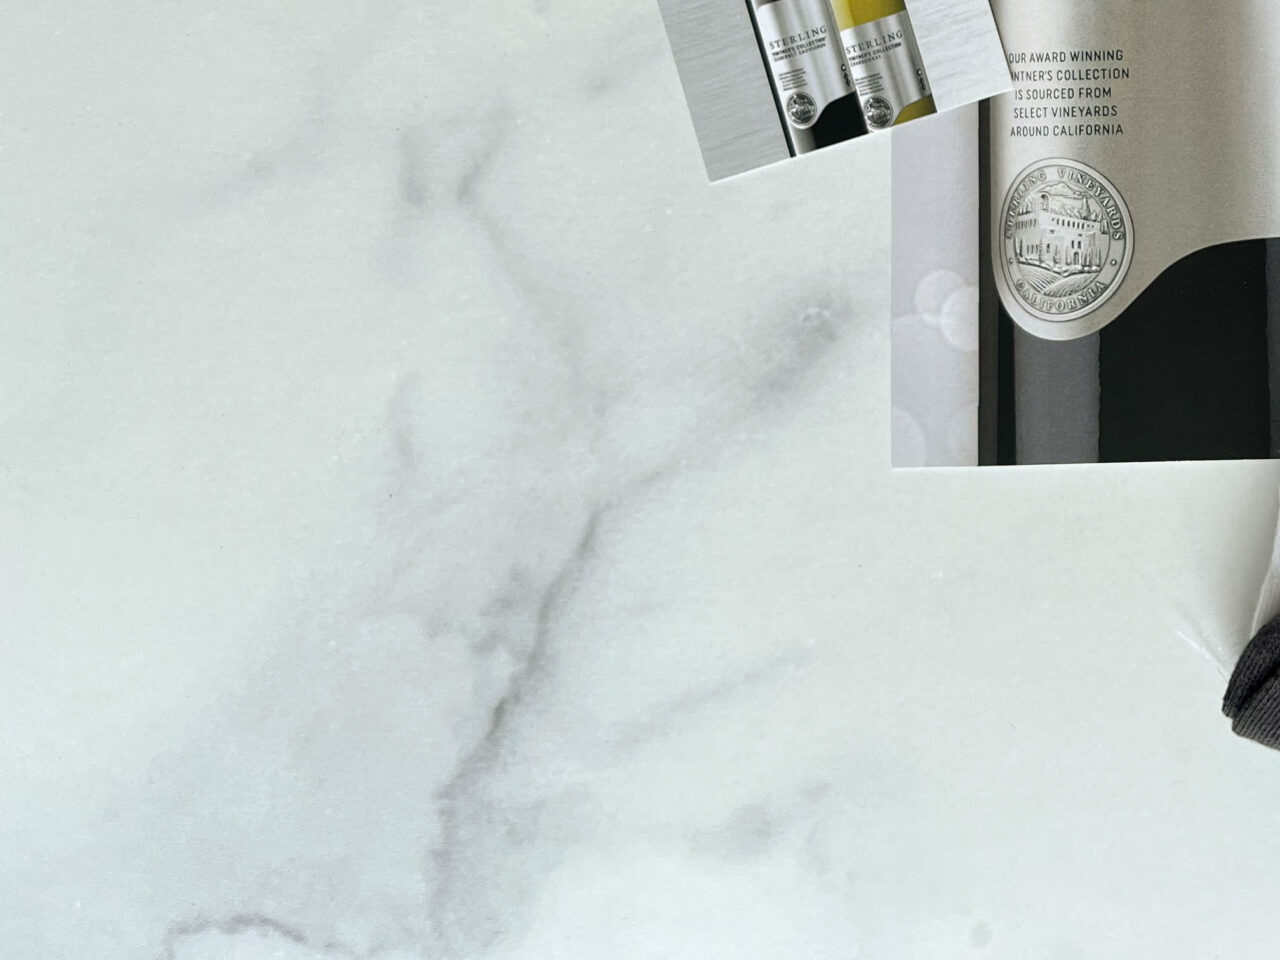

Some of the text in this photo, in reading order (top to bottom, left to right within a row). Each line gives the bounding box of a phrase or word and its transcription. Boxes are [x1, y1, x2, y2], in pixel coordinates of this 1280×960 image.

[769, 25, 827, 50] STERLING
[846, 30, 903, 55] STERLING
[1009, 49, 1124, 64] OUR AWARD WINNING
[1056, 68, 1130, 81] COLLECTION
[1015, 87, 1112, 100] IS SOURCED FROM
[1013, 105, 1118, 119] SELECT VINEYARDS
[1010, 124, 1124, 137] AROUND CALIFORNIA
[1057, 167, 1123, 240] VINEYARDS
[1016, 279, 1106, 312] CALIFORNIA
